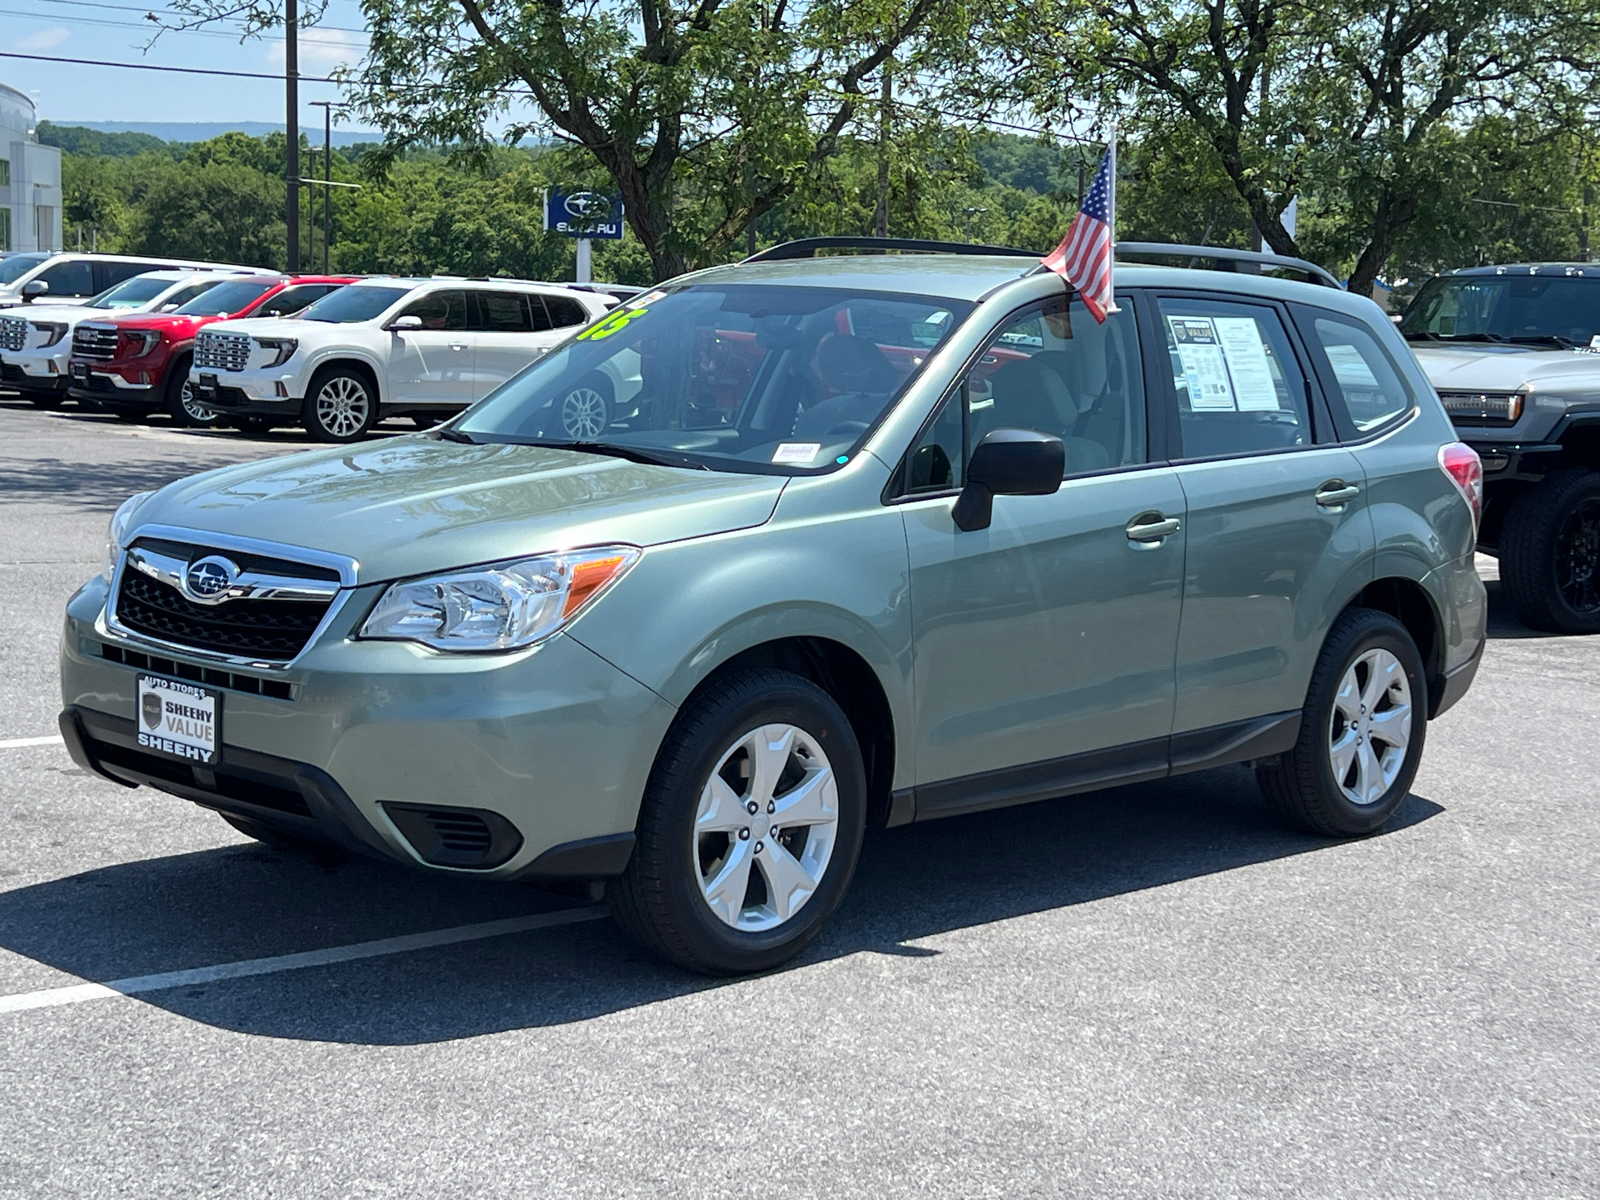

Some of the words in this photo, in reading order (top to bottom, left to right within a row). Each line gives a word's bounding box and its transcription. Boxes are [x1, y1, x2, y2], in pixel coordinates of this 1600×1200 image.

[556, 222, 616, 234] SUARU
[576, 309, 649, 340] 15
[1186, 328, 1213, 338] VALUE
[144, 676, 168, 689] AUTO
[169, 682, 206, 698] STORES
[165, 701, 212, 723] SHEEHY
[165, 715, 213, 742] VALUE
[137, 733, 213, 762] SHEEHY
